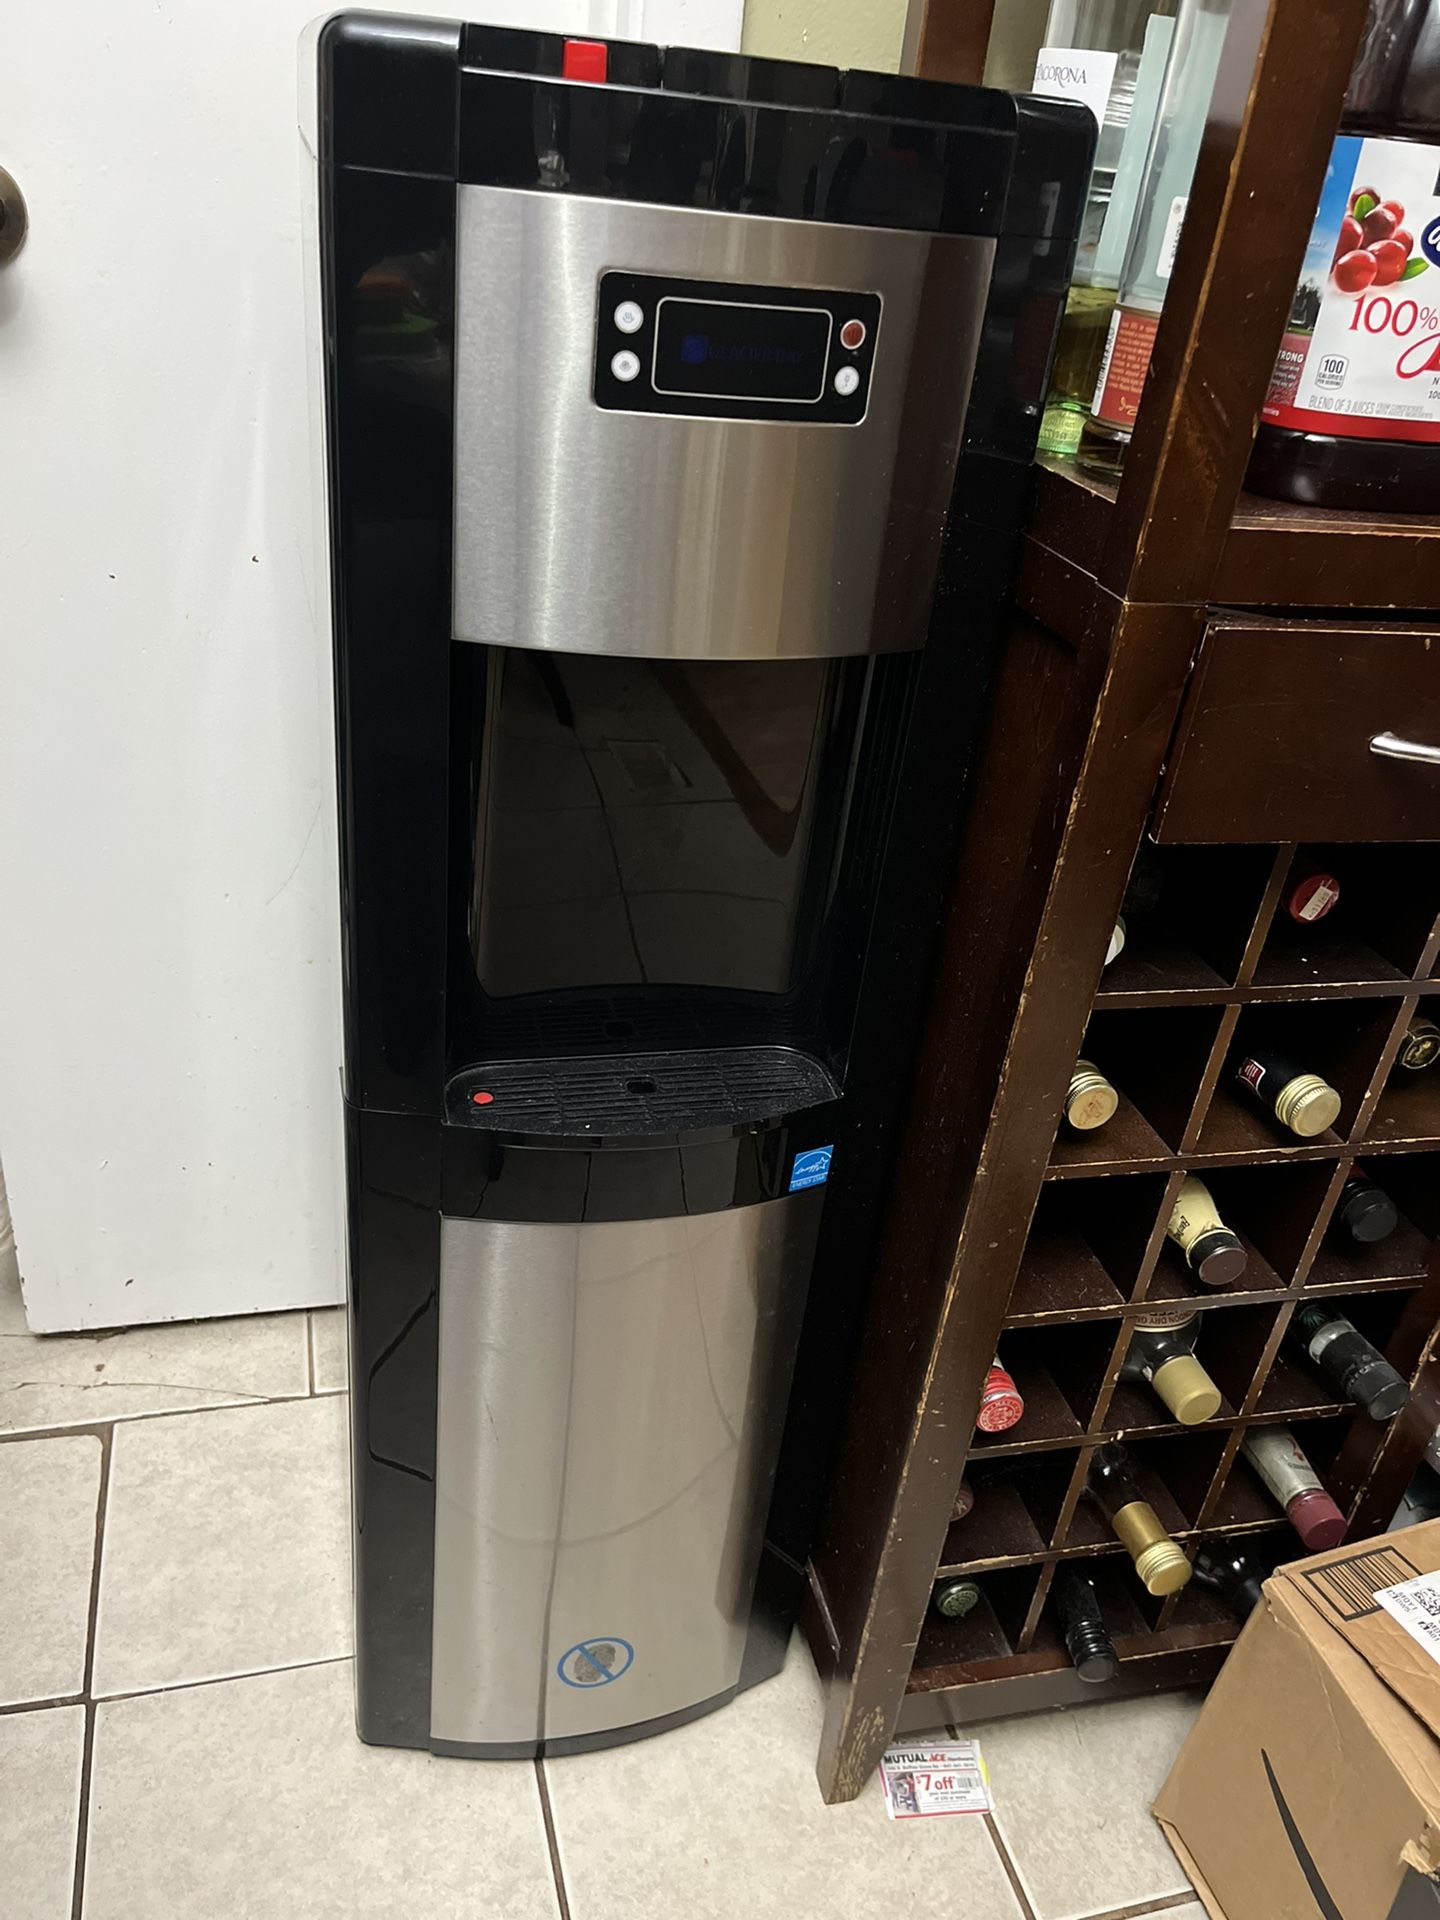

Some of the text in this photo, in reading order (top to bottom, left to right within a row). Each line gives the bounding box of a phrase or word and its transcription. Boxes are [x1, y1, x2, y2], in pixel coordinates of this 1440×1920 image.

[1348, 293, 1438, 336] 100%
[1323, 358, 1345, 374] 100
[1308, 395, 1334, 410] BLEND
[1334, 398, 1345, 411] OF
[1345, 400, 1352, 412] 3
[1351, 401, 1375, 415] JUICES
[884, 1753, 927, 1764] MUTUAL
[929, 1753, 947, 1763] ACE
